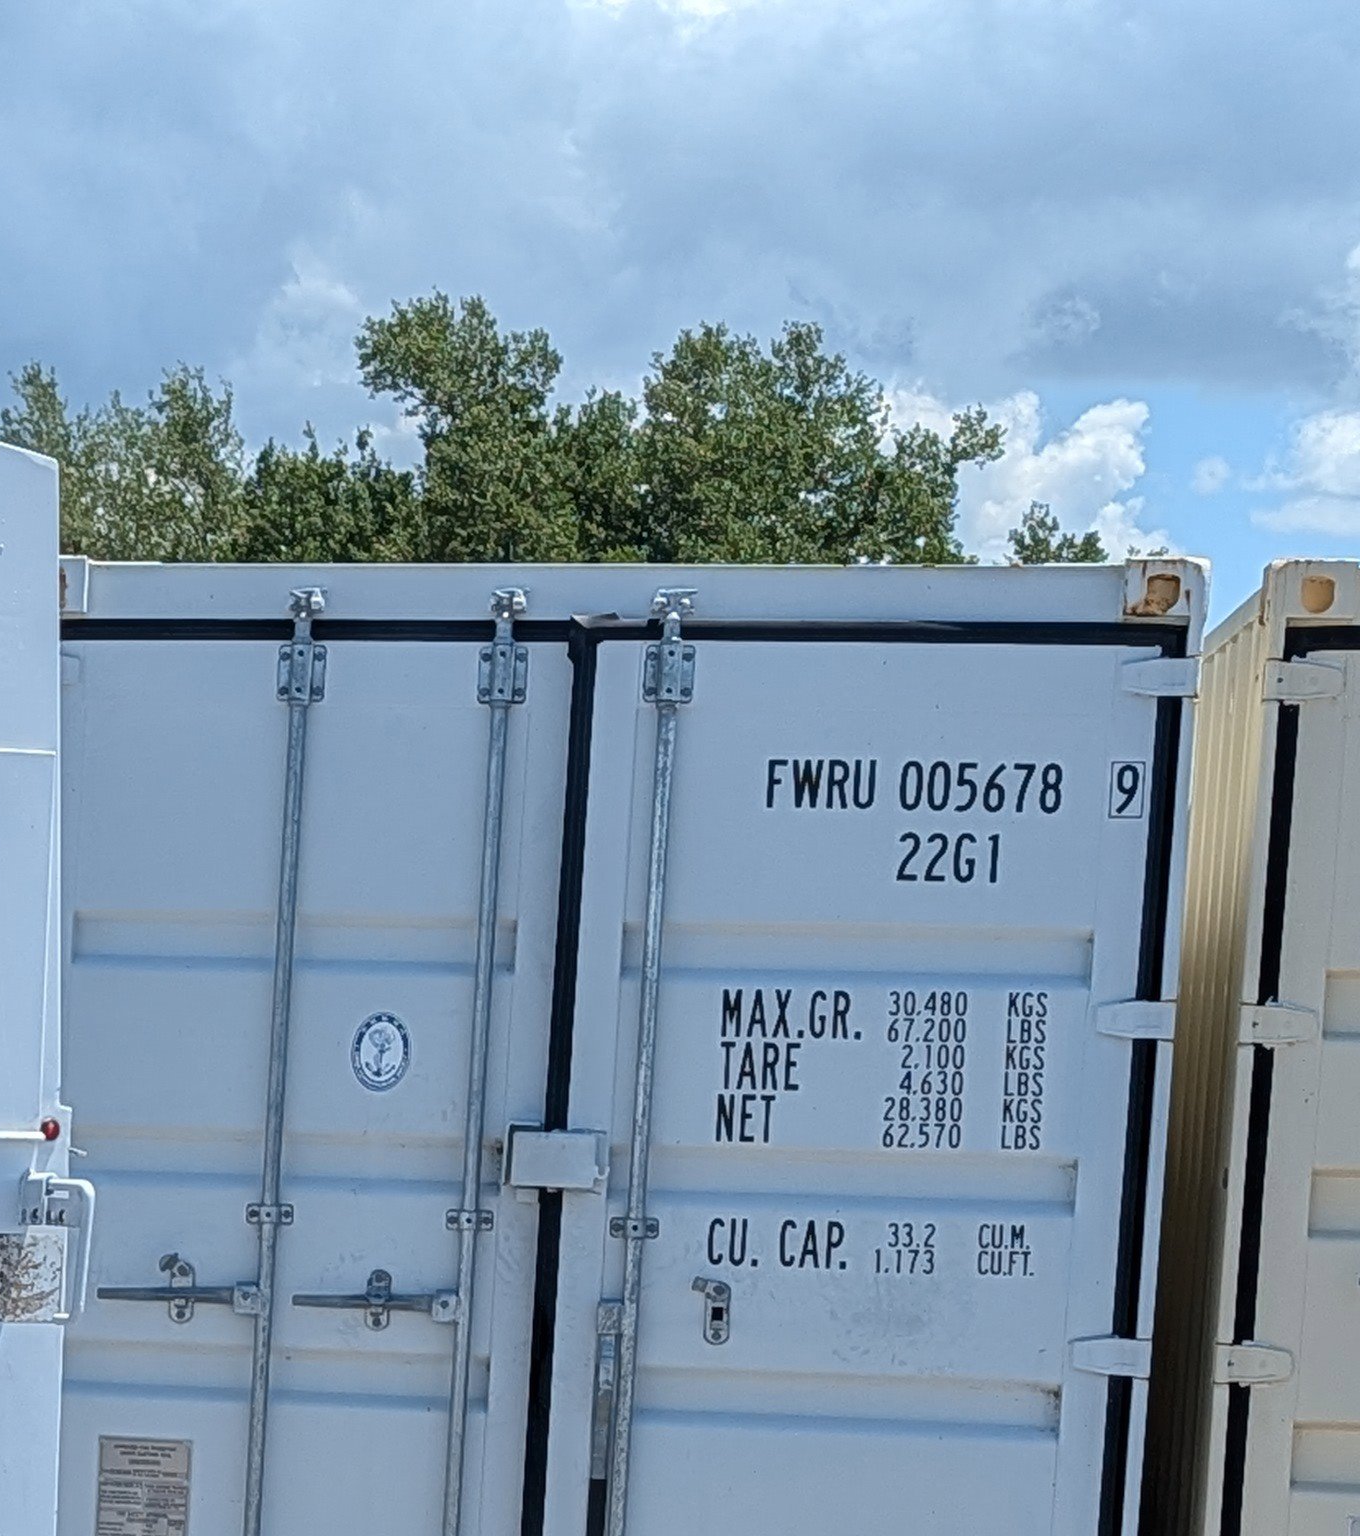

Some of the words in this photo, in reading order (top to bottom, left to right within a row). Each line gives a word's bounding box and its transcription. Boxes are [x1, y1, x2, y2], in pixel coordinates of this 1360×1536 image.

[767, 760, 876, 809] FWRU
[900, 761, 1062, 814] 005678
[1116, 765, 1140, 814] 9
[897, 832, 999, 883] 22G1
[721, 989, 861, 1040] MAX.GR.
[889, 991, 967, 1017] 30.480
[1008, 993, 1047, 1018] KGS
[888, 1018, 965, 1043] 67.200
[1007, 1019, 1046, 1044] LBS
[720, 1042, 800, 1091] TARE
[901, 1045, 964, 1069] 2.100
[1006, 1045, 1044, 1070] KGS
[899, 1071, 963, 1096] 4.630
[1004, 1072, 1043, 1097] LBS
[716, 1094, 775, 1142] NET
[884, 1097, 962, 1121] 28.380
[1003, 1099, 1042, 1123] KGS
[883, 1123, 960, 1148] 62.570
[1002, 1125, 1040, 1150] LBS
[708, 1218, 757, 1266] CU.
[780, 1220, 846, 1269] CAP.
[889, 1223, 935, 1248] 33.2
[979, 1224, 1029, 1249] CU.M.
[876, 1249, 934, 1274] 1.173
